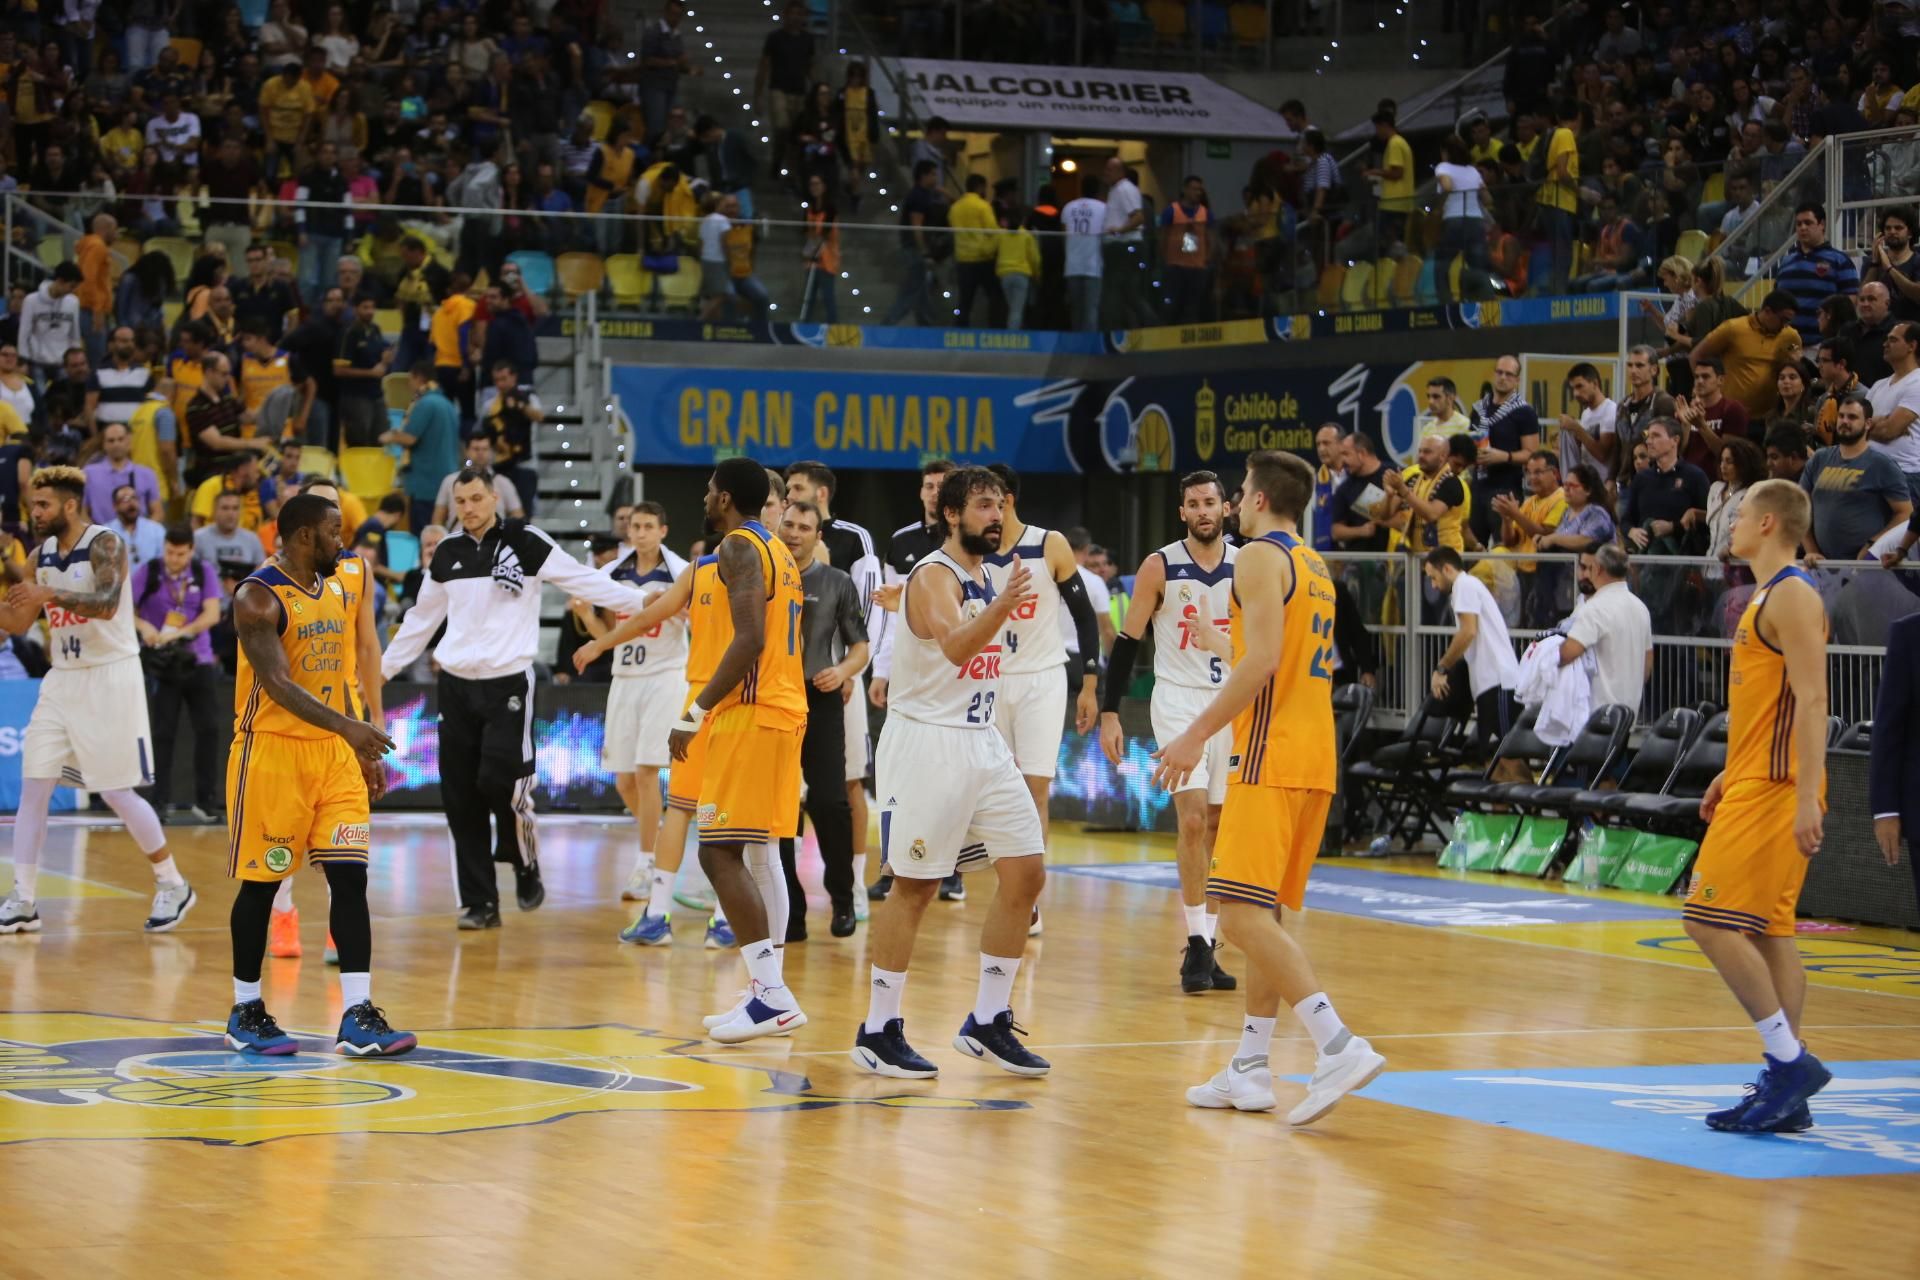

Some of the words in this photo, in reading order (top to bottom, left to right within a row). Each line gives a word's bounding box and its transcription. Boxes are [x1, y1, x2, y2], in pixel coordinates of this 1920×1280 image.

[901, 70, 1193, 104] HALCOURIER
[934, 97, 1008, 110] equipo
[1018, 101, 1046, 110] un
[1051, 101, 1122, 114] mismo
[1128, 103, 1211, 118] objetivo
[1224, 392, 1278, 422] Cabildo
[1279, 391, 1298, 420] de
[679, 387, 793, 448] GRAN
[814, 391, 996, 454] CANARIA
[1224, 425, 1257, 451] Gran
[1259, 423, 1313, 450] Canaria
[1814, 466, 1866, 491] NIKE
[621, 645, 646, 666] 20
[1210, 657, 1222, 684] 5
[321, 686, 332, 706] 7
[967, 691, 995, 723] 23
